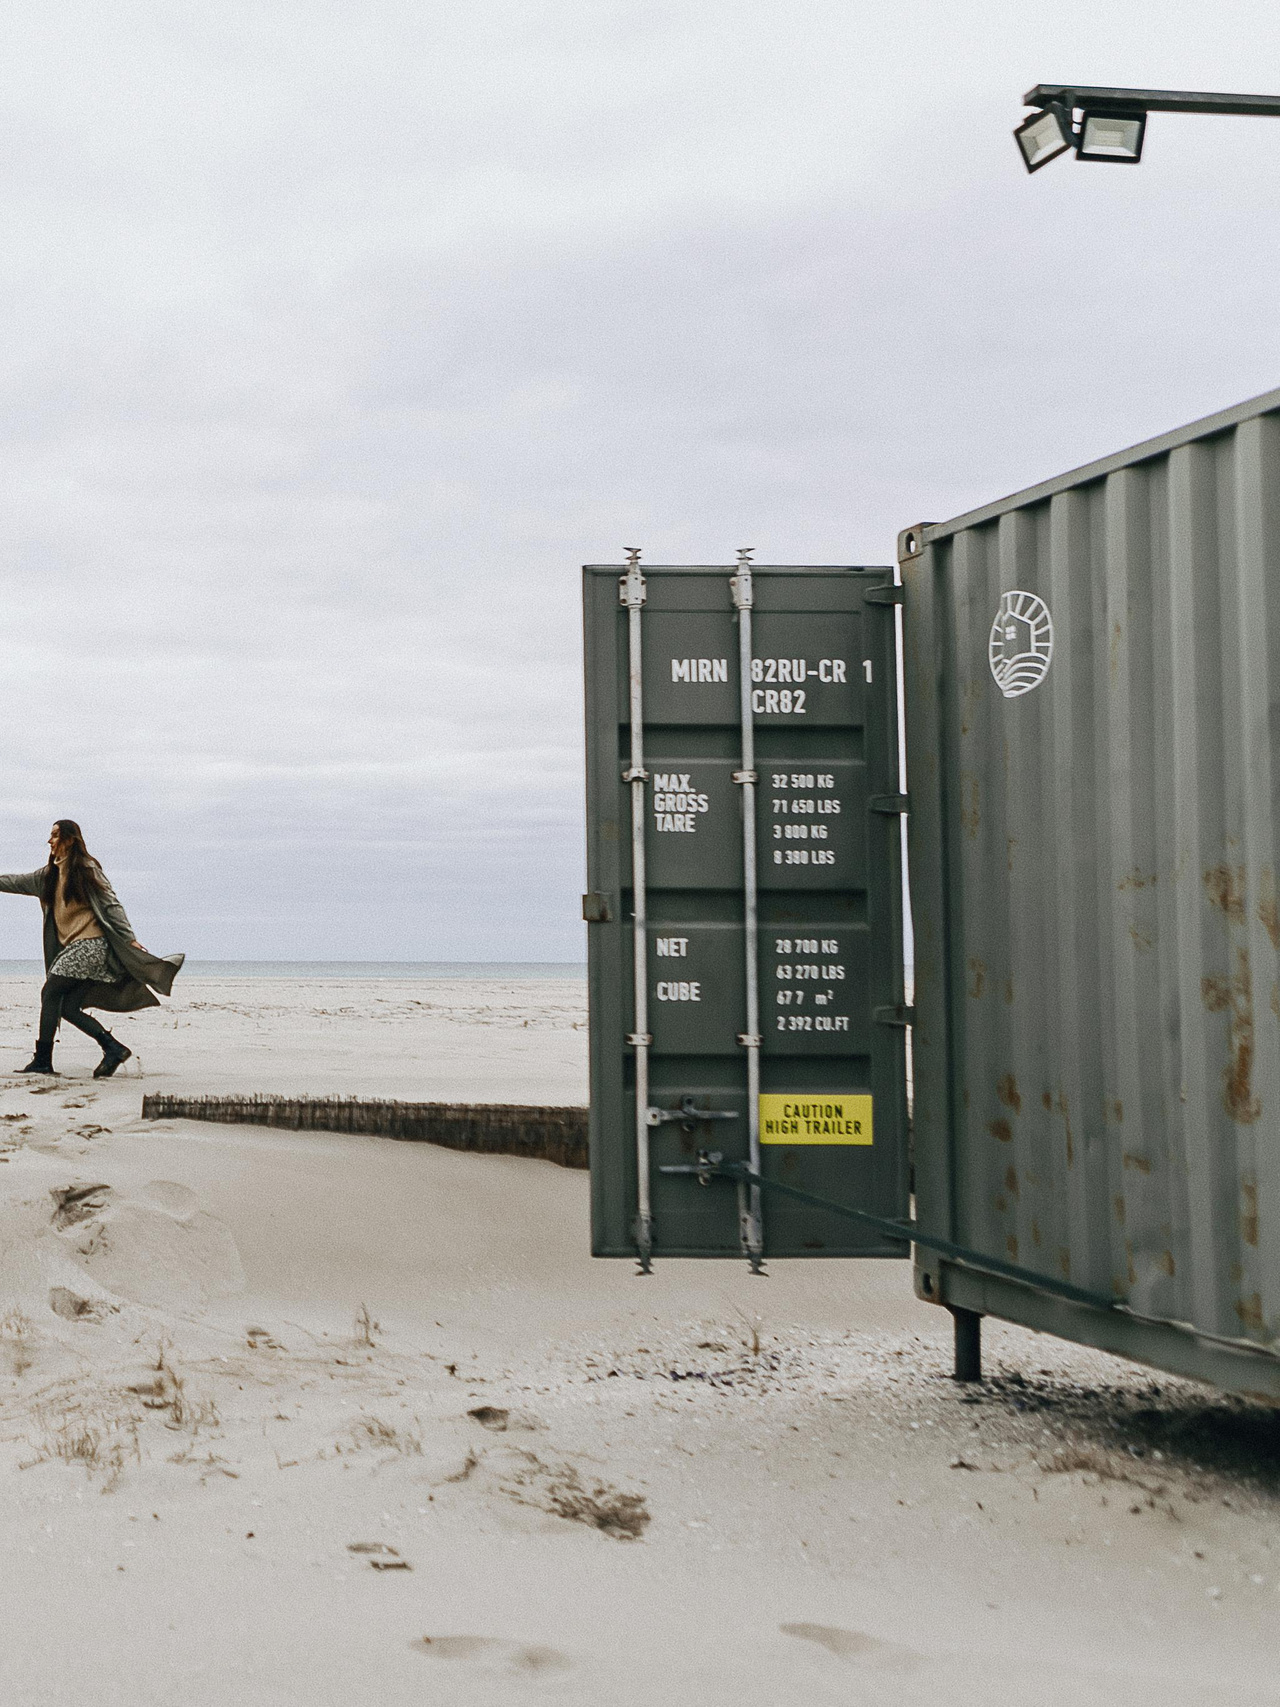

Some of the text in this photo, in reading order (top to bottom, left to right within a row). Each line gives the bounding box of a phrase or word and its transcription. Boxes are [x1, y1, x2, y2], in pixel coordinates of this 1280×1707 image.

[671, 659, 873, 683] MIRN 82RU-CR 1
[752, 690, 806, 713] CR82
[654, 774, 696, 792] MAX.
[772, 774, 834, 788] 32 500 KG
[654, 794, 709, 812] GROSS
[772, 799, 841, 813] 71 650 LBS
[654, 813, 696, 832] TARE
[773, 825, 782, 839] 3
[810, 825, 828, 839] KG
[773, 850, 782, 865] 8
[811, 850, 835, 865] LBS
[657, 938, 688, 956] NET
[775, 939, 839, 954] 28 700 KG
[776, 965, 845, 979] 63 270 LBS
[657, 982, 701, 1001] CUBE
[776, 1016, 849, 1031] 2 392 CU.FT
[784, 1104, 843, 1118] CAUTION
[765, 1120, 862, 1135] HIGH TRAILER
